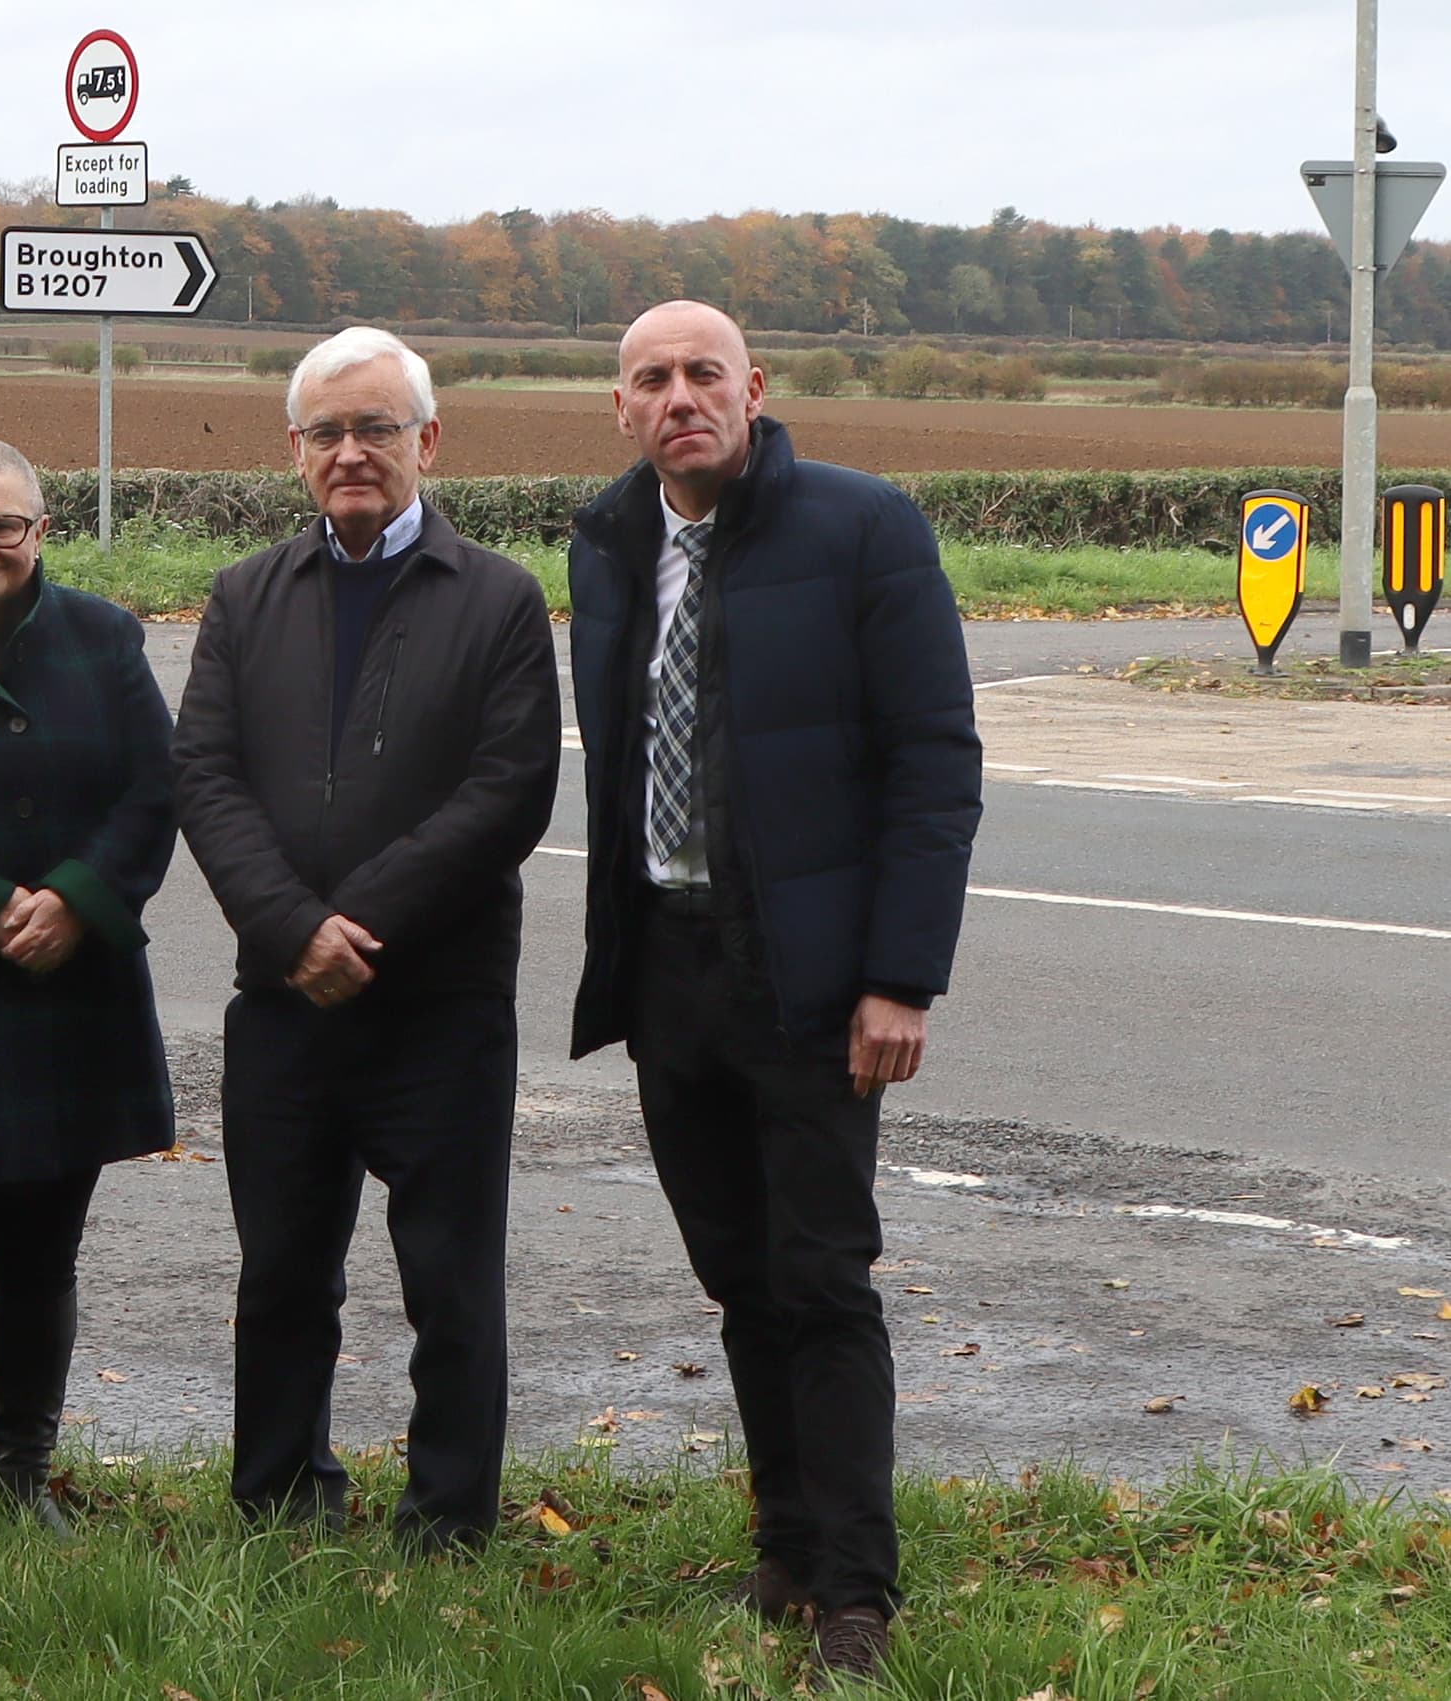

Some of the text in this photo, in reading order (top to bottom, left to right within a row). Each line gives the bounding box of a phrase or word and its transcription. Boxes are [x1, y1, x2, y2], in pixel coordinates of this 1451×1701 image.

[65, 154, 140, 174] Except for
[75, 177, 128, 197] loading
[17, 243, 163, 271] Broughton
